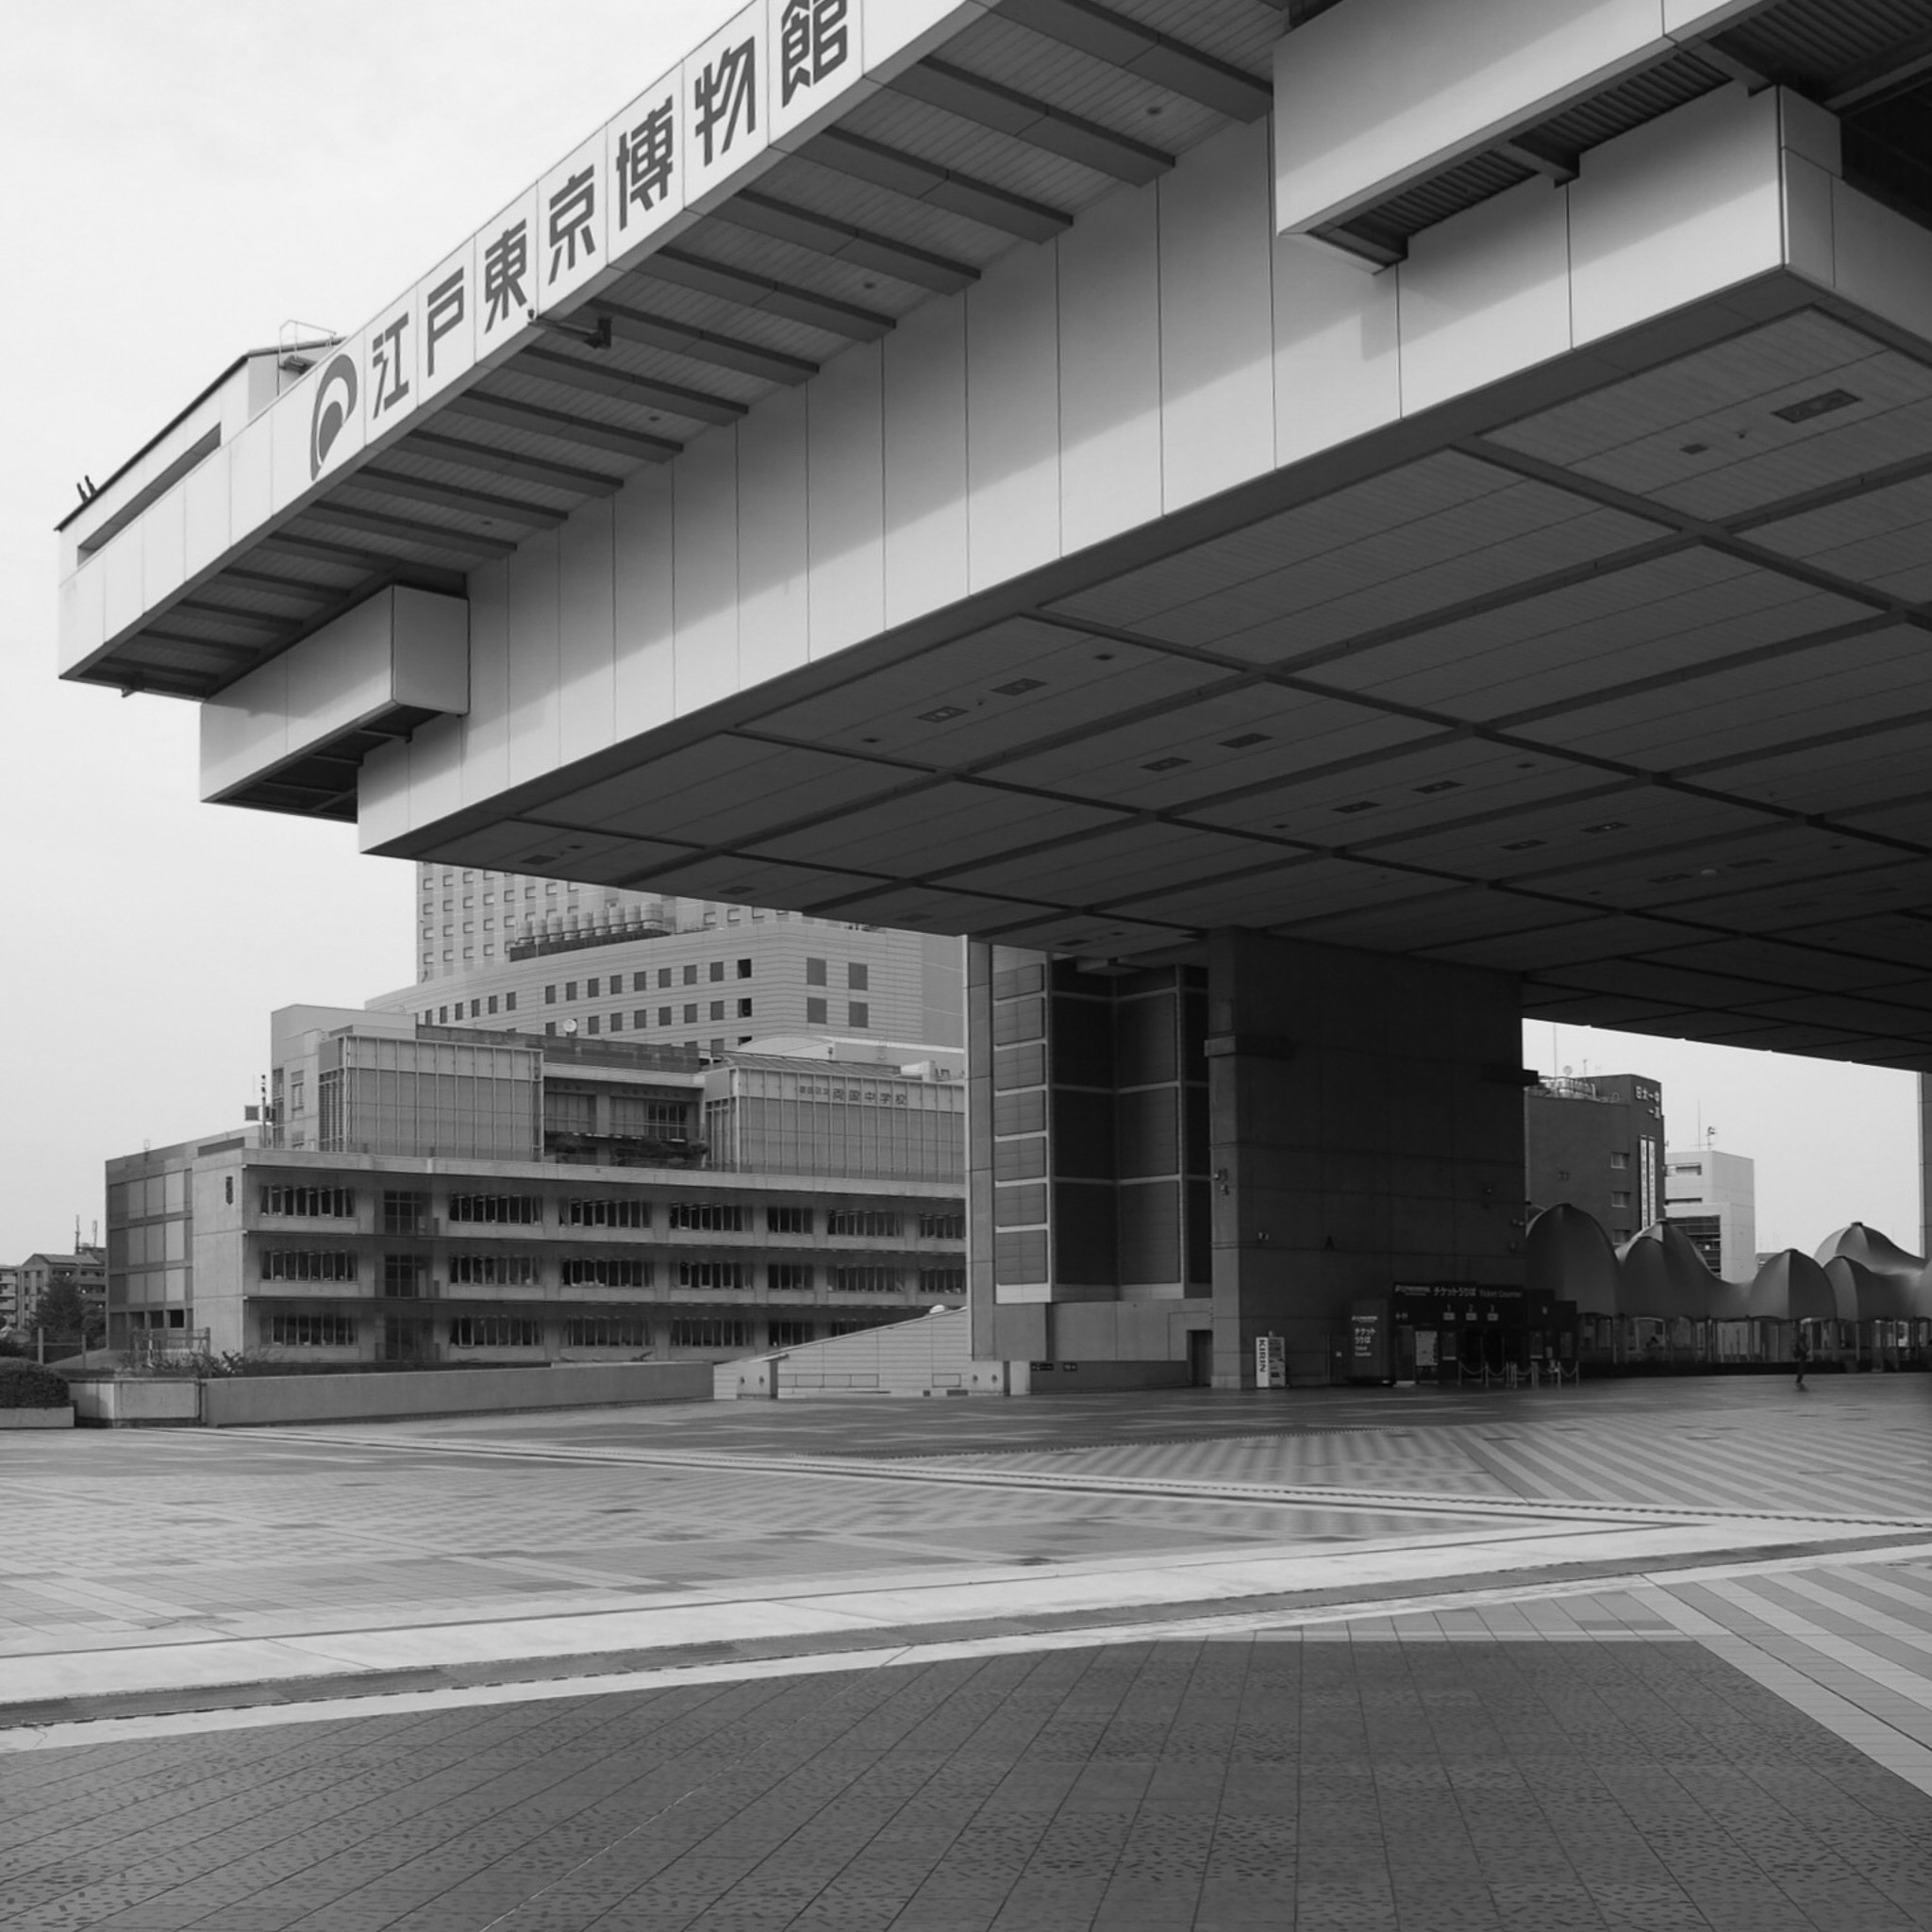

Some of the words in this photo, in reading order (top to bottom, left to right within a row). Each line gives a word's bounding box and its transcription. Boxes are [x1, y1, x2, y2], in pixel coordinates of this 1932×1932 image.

[372, 0, 848, 420] 江戸東京博物館
